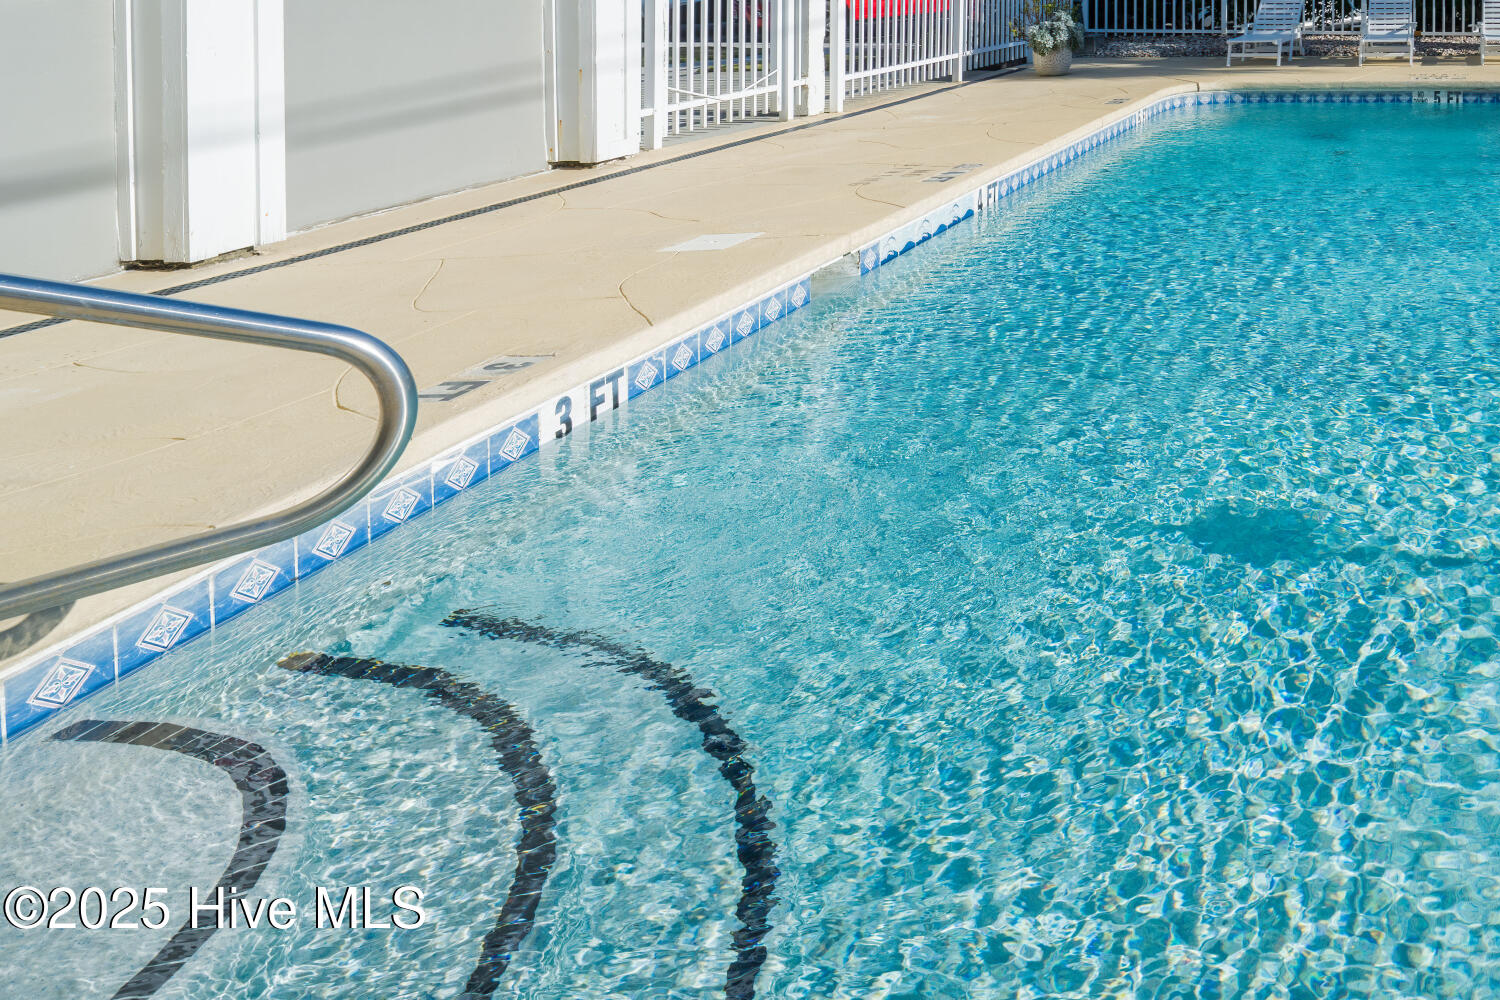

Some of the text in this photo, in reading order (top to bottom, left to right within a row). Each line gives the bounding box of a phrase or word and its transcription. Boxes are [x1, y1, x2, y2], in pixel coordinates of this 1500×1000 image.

[1433, 91, 1441, 104] 5
[1446, 91, 1461, 104] FT
[986, 182, 998, 208] FT
[555, 367, 625, 438] 3 FT
